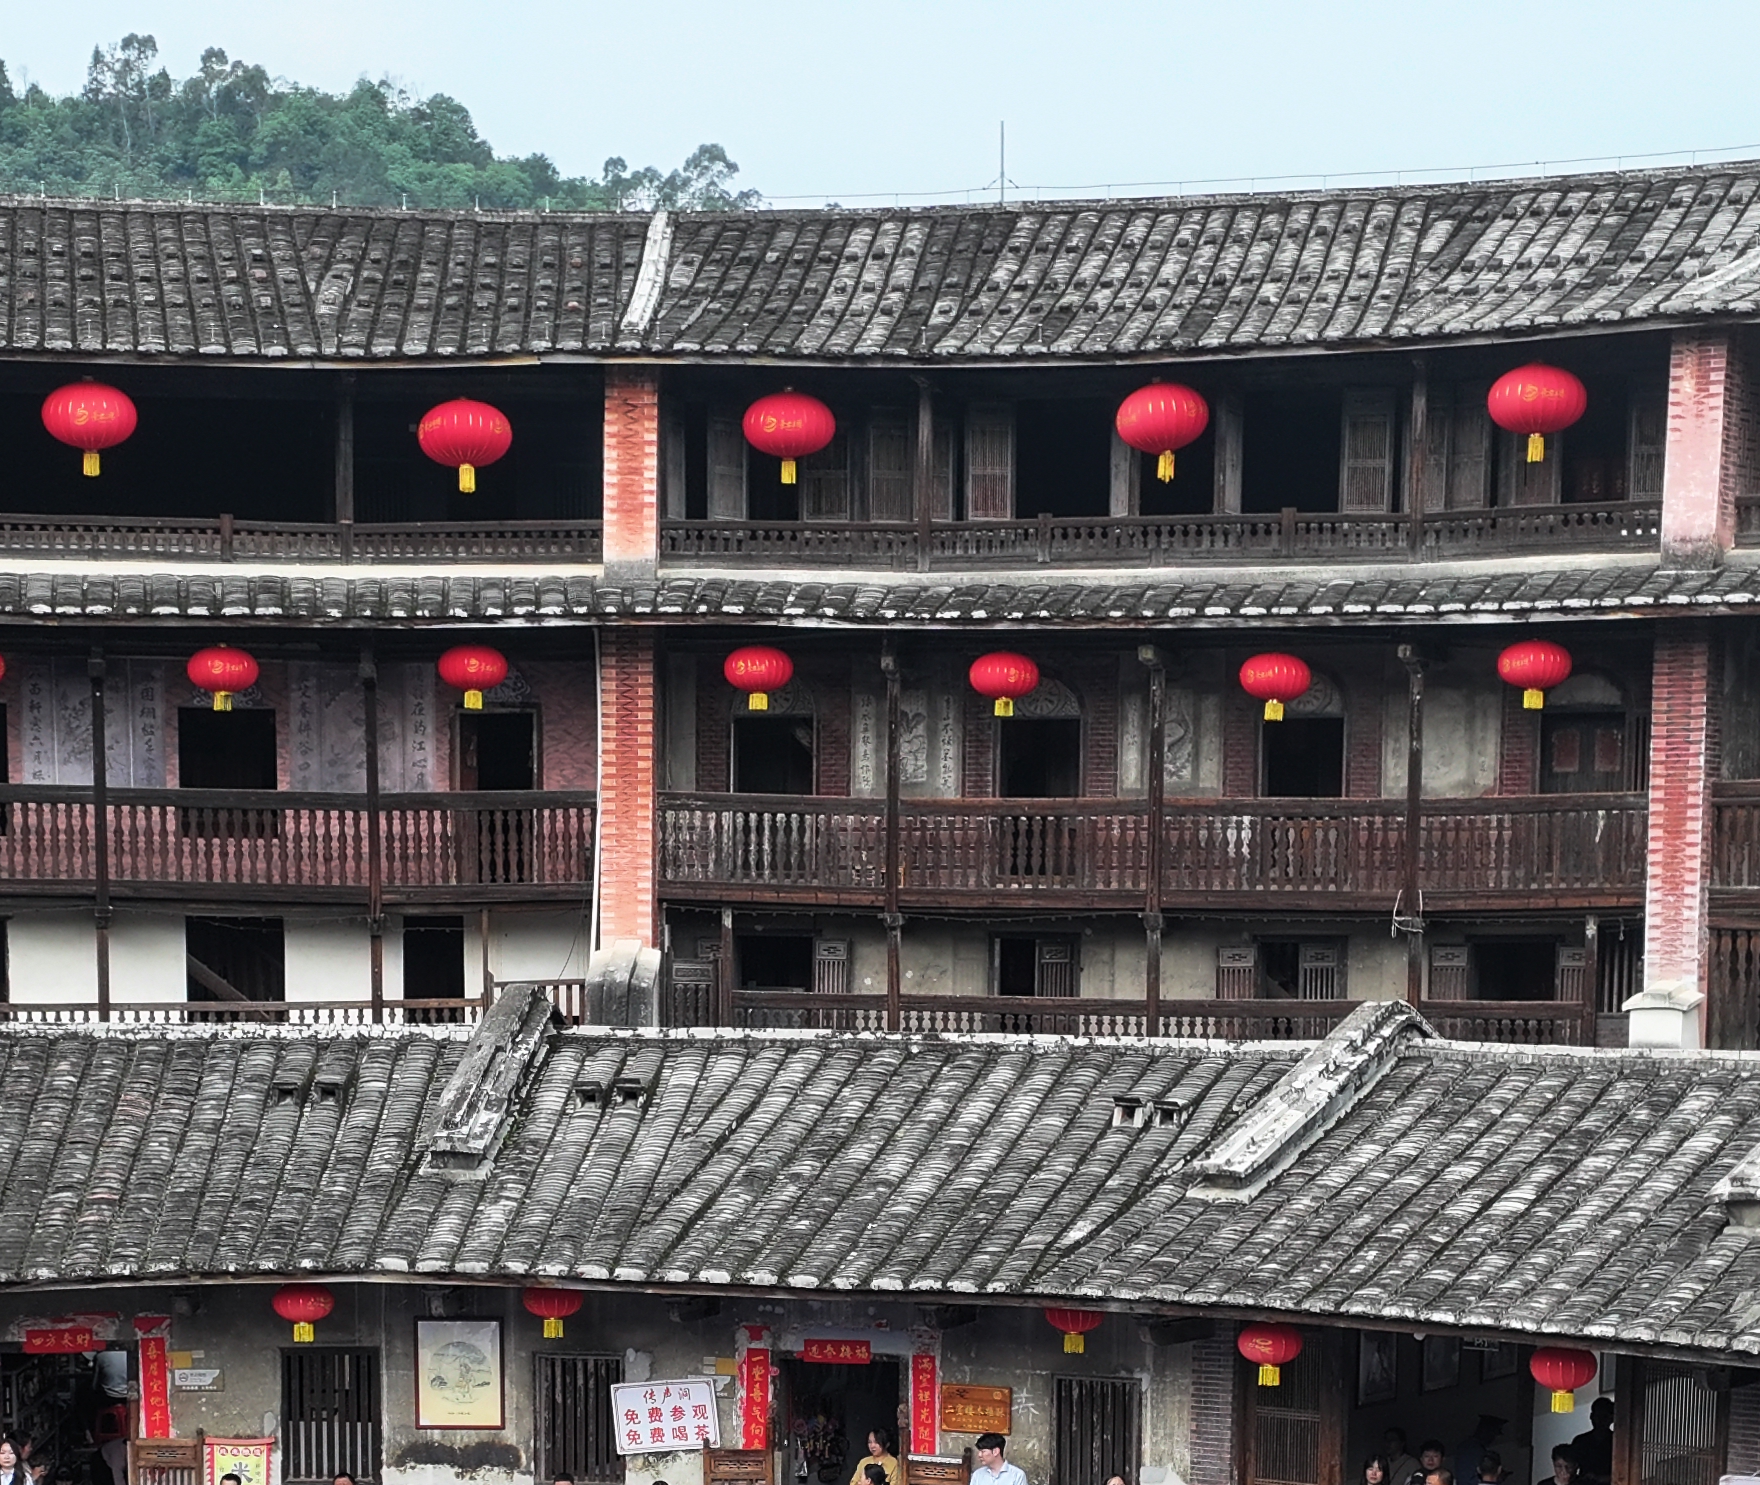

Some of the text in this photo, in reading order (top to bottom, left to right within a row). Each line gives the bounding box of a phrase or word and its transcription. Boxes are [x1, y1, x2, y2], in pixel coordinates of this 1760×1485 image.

[642, 1387, 692, 1404] 传声洞
[624, 1403, 708, 1427] 免费参观
[626, 1424, 710, 1446] 免费喝茶
